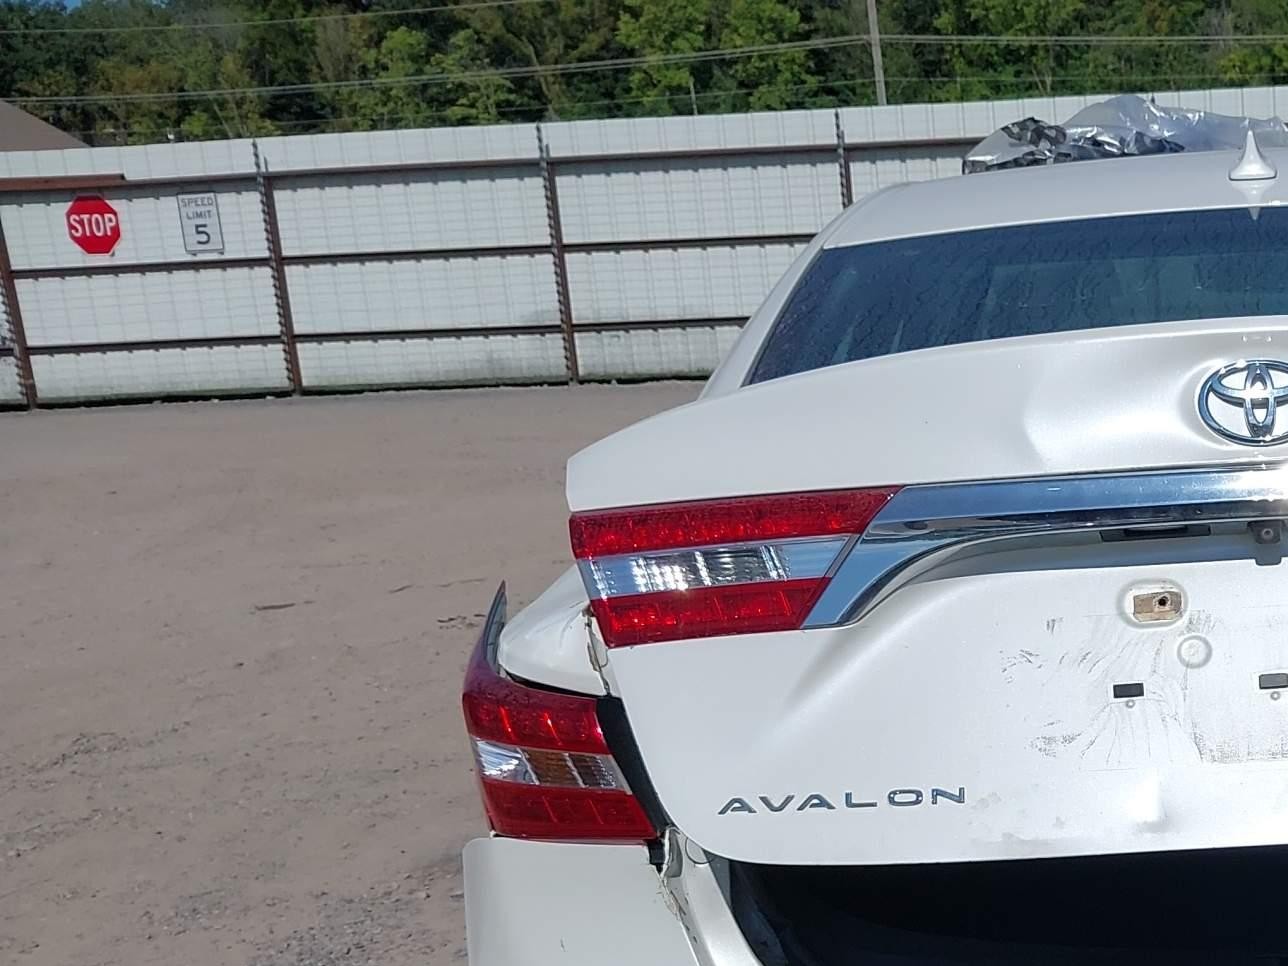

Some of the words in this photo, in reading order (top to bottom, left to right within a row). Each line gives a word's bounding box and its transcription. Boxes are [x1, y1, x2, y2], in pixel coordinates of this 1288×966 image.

[181, 197, 214, 208] SPEED
[69, 213, 116, 238] STOP
[186, 210, 212, 220] LIMIT
[194, 224, 211, 245] 5
[718, 787, 965, 815] AVALON
